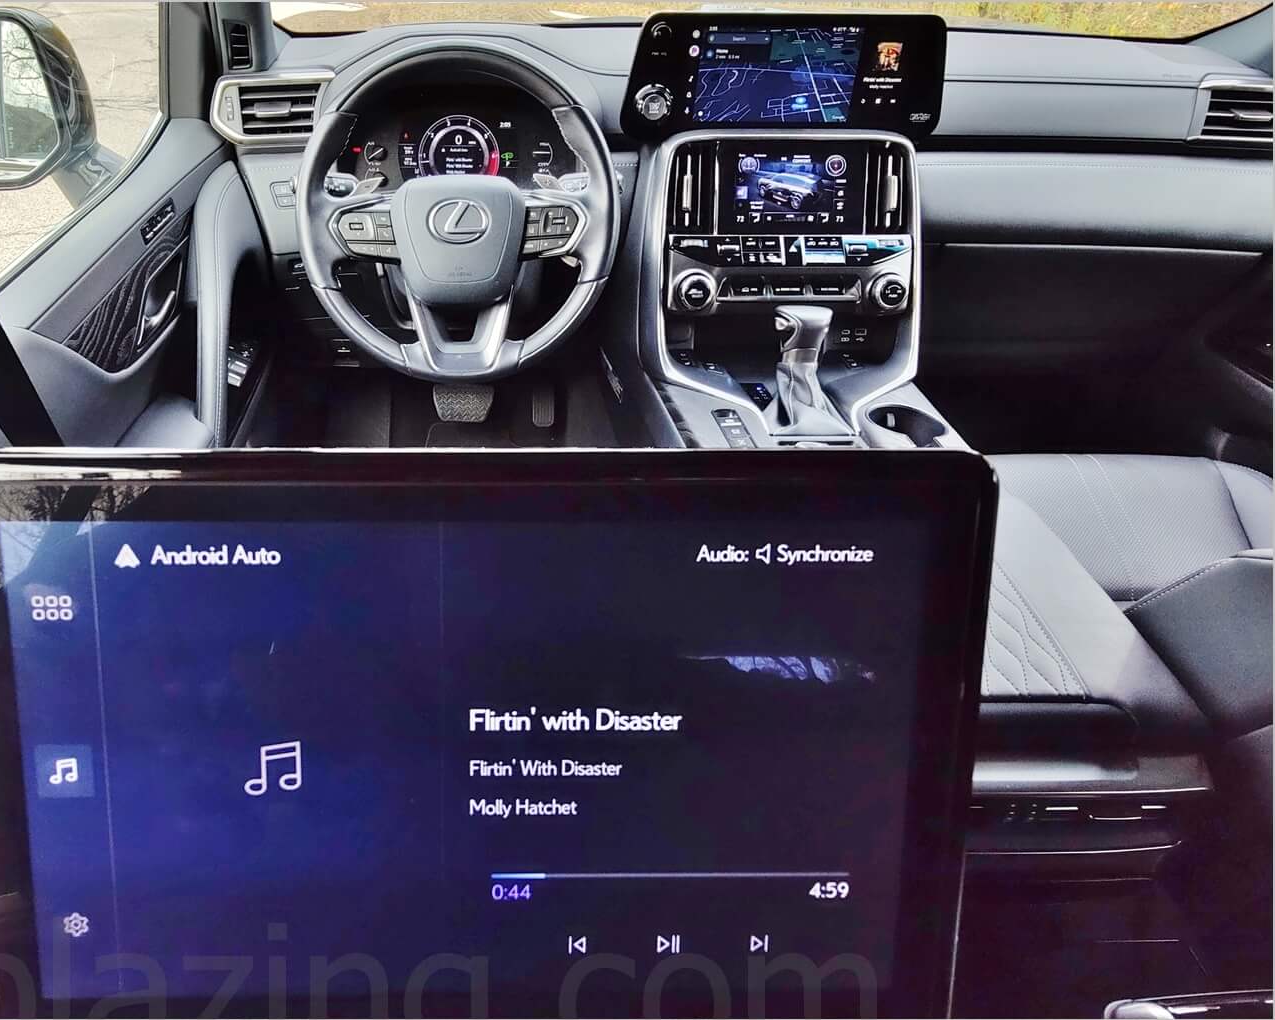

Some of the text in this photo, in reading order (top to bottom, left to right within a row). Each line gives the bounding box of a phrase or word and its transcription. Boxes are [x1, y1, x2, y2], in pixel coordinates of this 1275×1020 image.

[455, 134, 463, 145] 0
[150, 544, 282, 566] Android Auto
[696, 544, 874, 566] Audio: Synchronize
[468, 706, 683, 732] Flirtin' with Disaster
[468, 758, 623, 777] Flirtin' With Disaster
[468, 799, 578, 819] Molly Hatchet
[491, 883, 532, 901] 0:44
[809, 882, 850, 899] 4:59
